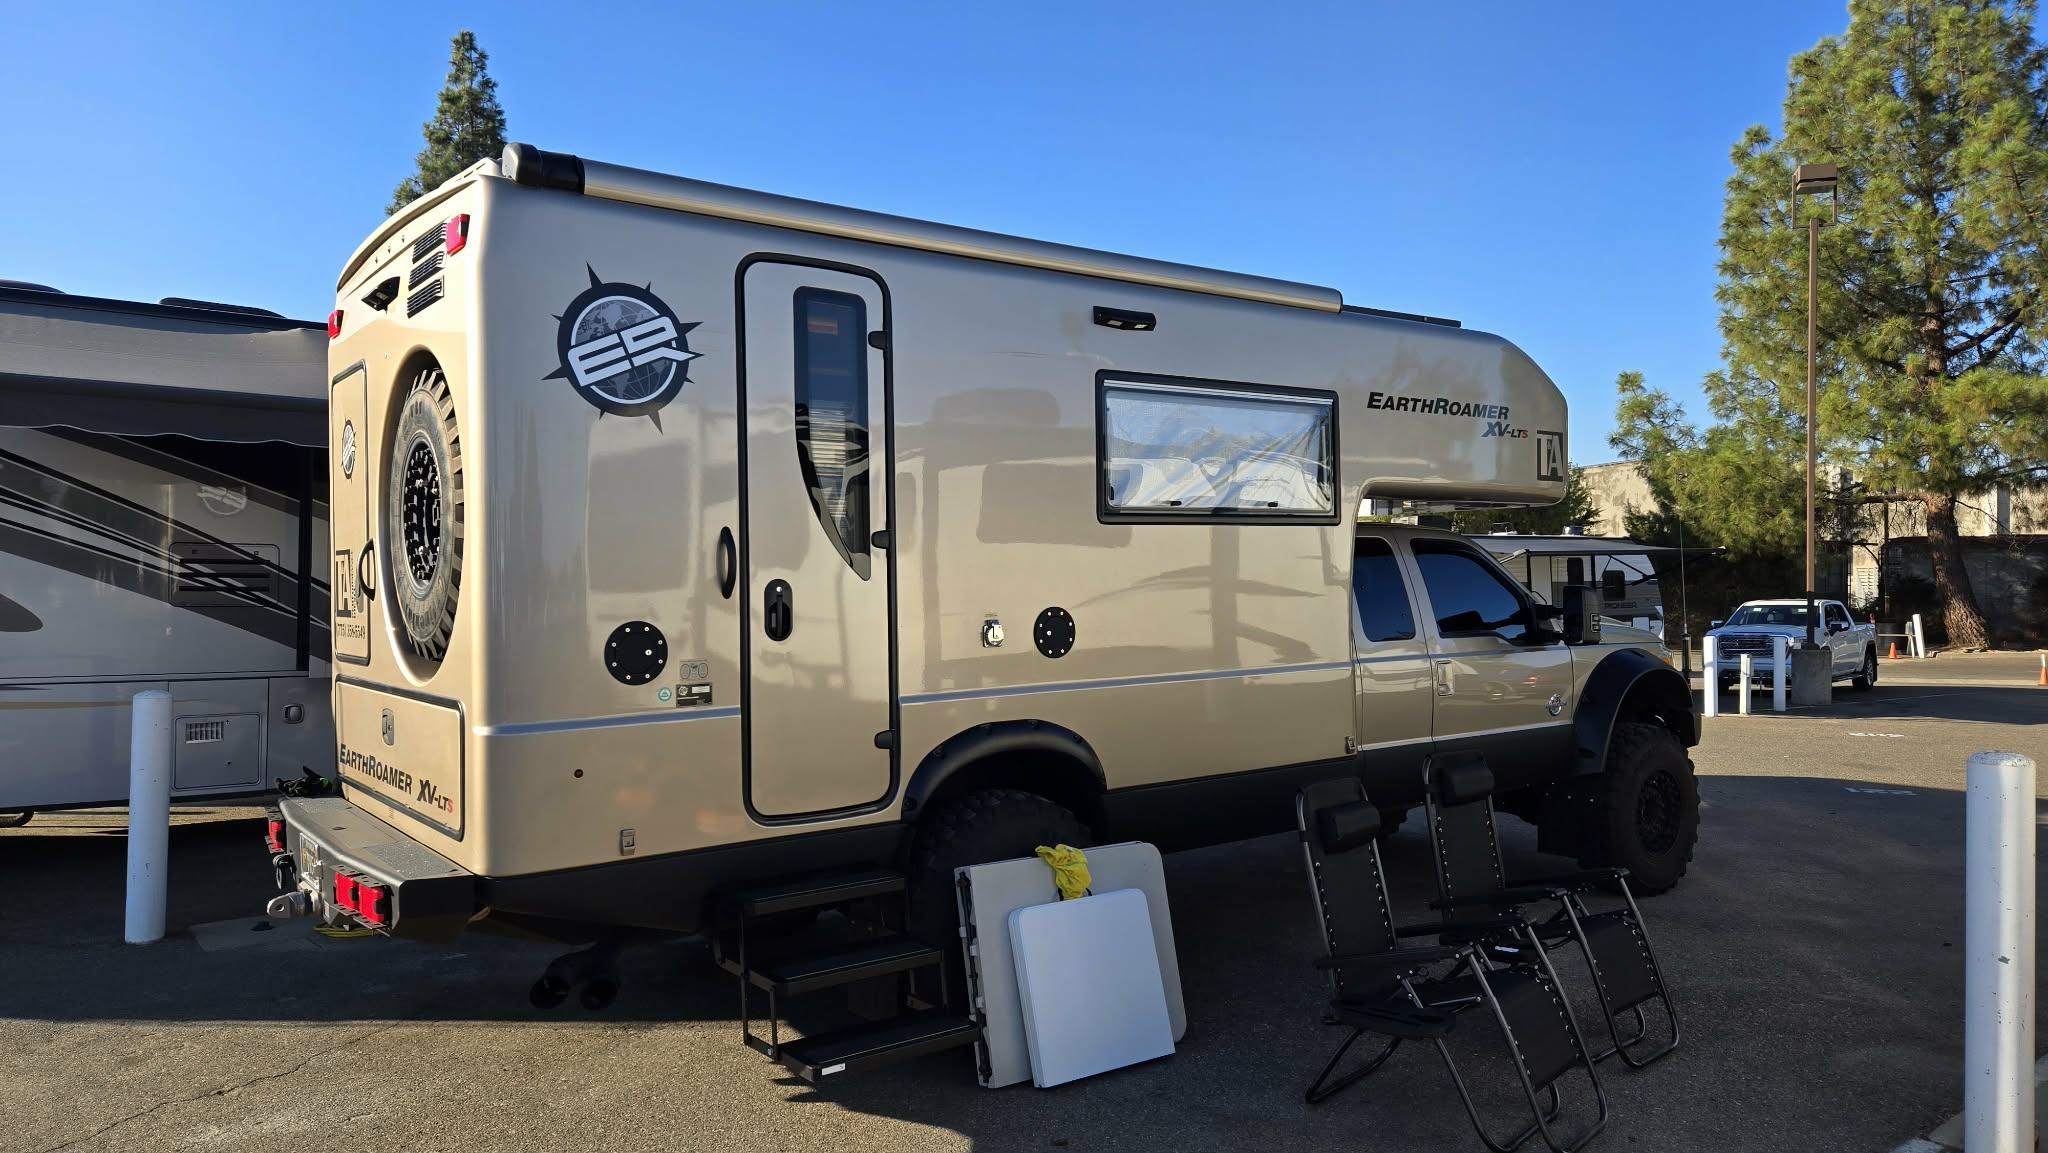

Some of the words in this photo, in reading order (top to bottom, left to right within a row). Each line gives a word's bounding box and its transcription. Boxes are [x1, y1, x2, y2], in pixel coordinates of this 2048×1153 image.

[567, 316, 697, 388] ER
[1481, 421, 1529, 439] XV-LTS
[416, 779, 453, 814] XV-LTS
